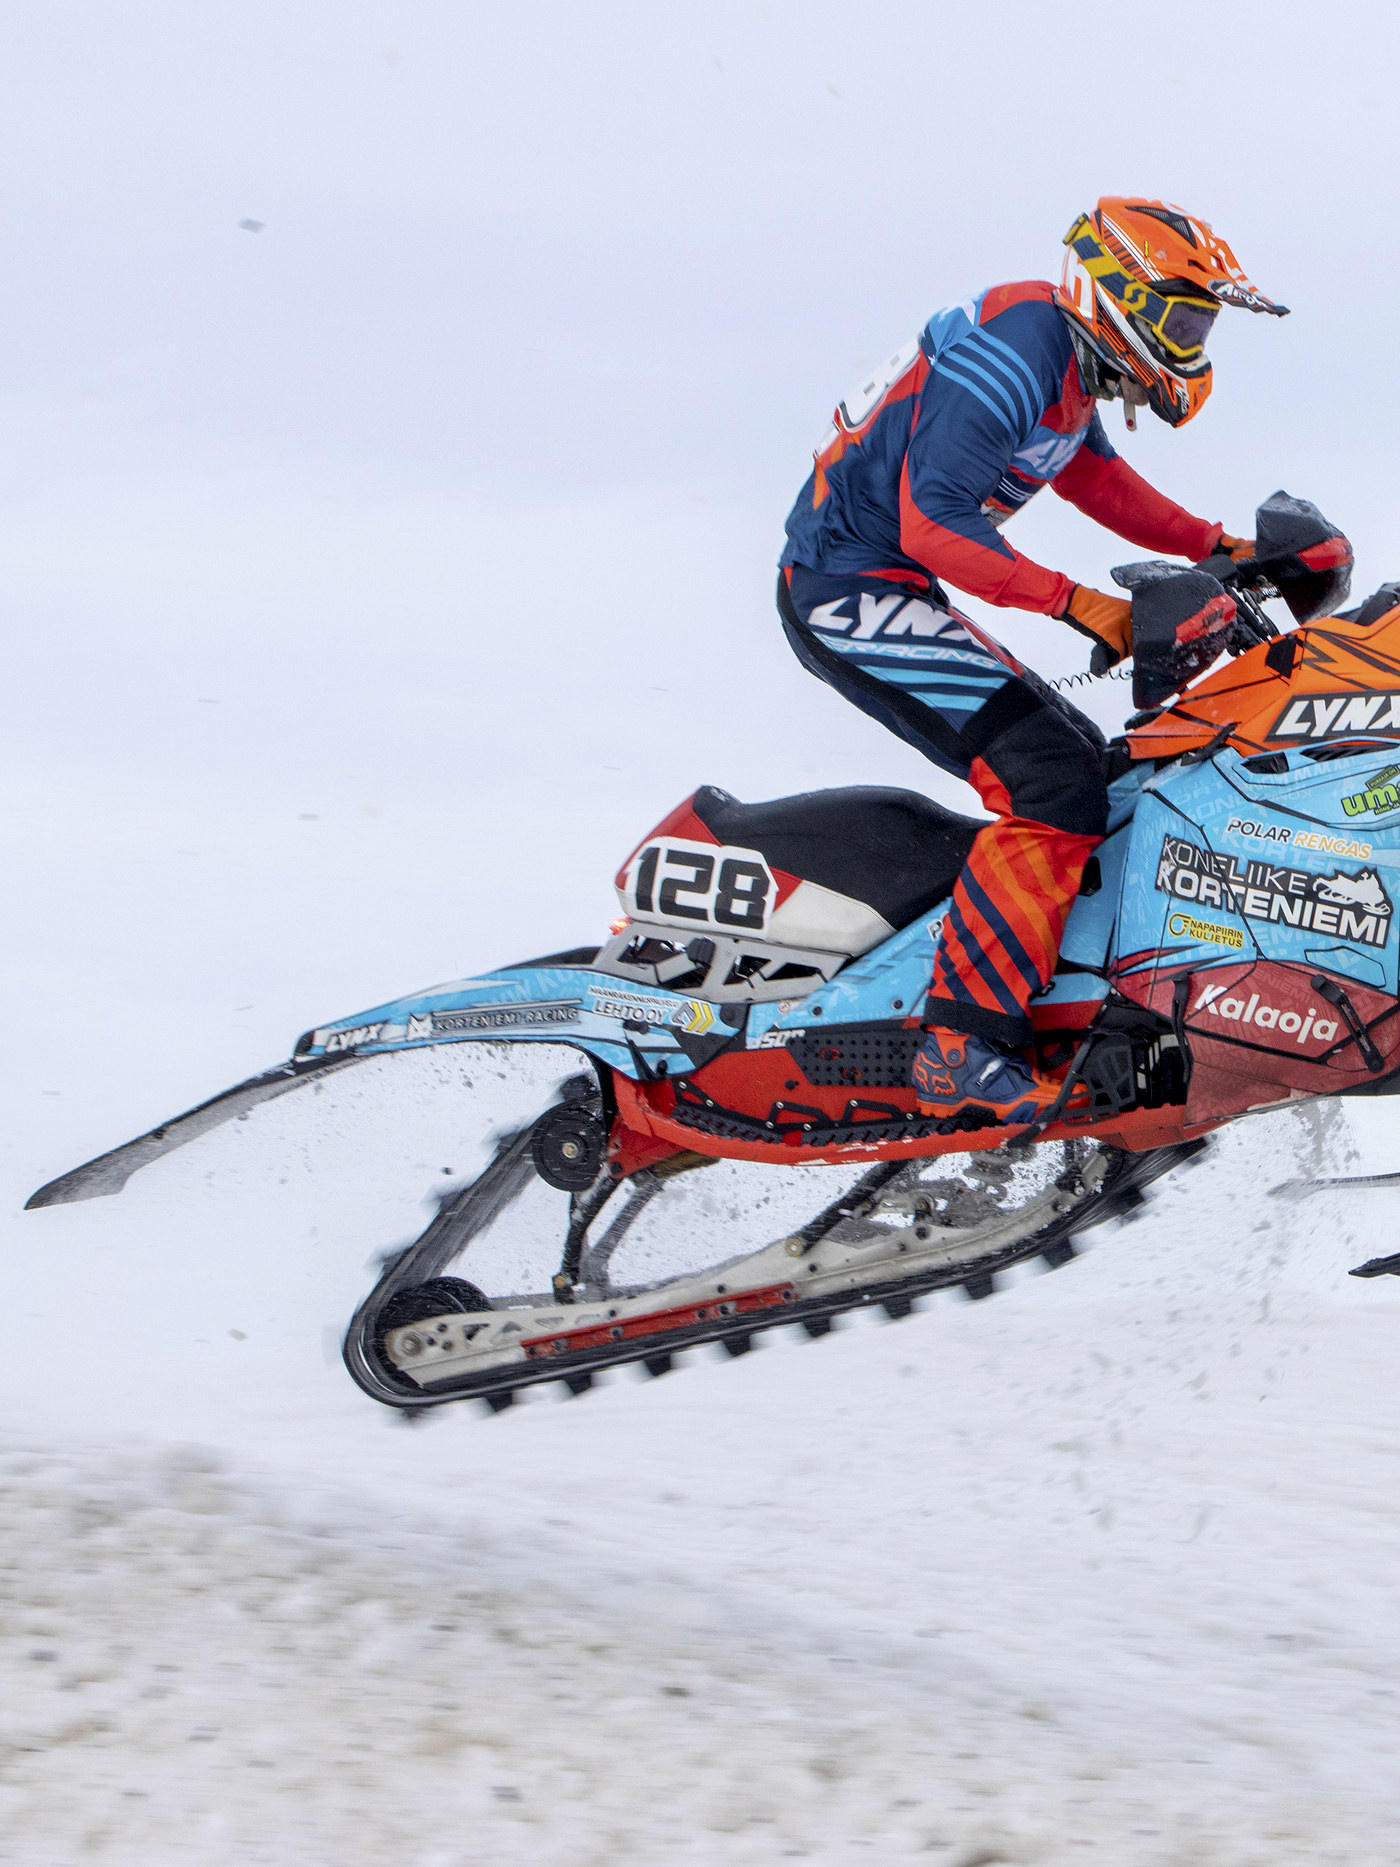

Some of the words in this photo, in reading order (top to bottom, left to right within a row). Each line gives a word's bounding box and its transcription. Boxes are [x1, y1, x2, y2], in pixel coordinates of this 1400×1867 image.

[1227, 818, 1292, 843] POLAR
[1294, 831, 1372, 860] RENGAS
[1161, 833, 1309, 896] KONELIIKE
[635, 846, 771, 931] 128
[1155, 863, 1389, 946] KORTENIEMI
[1188, 928, 1243, 948] KULJETUS
[1190, 920, 1244, 938] NAPAPIIRIN
[435, 1012, 523, 1032] KORTENIEMI
[525, 1007, 579, 1024] RACING
[1194, 983, 1339, 1044] Kalaoja
[323, 1021, 386, 1051] LYNX
